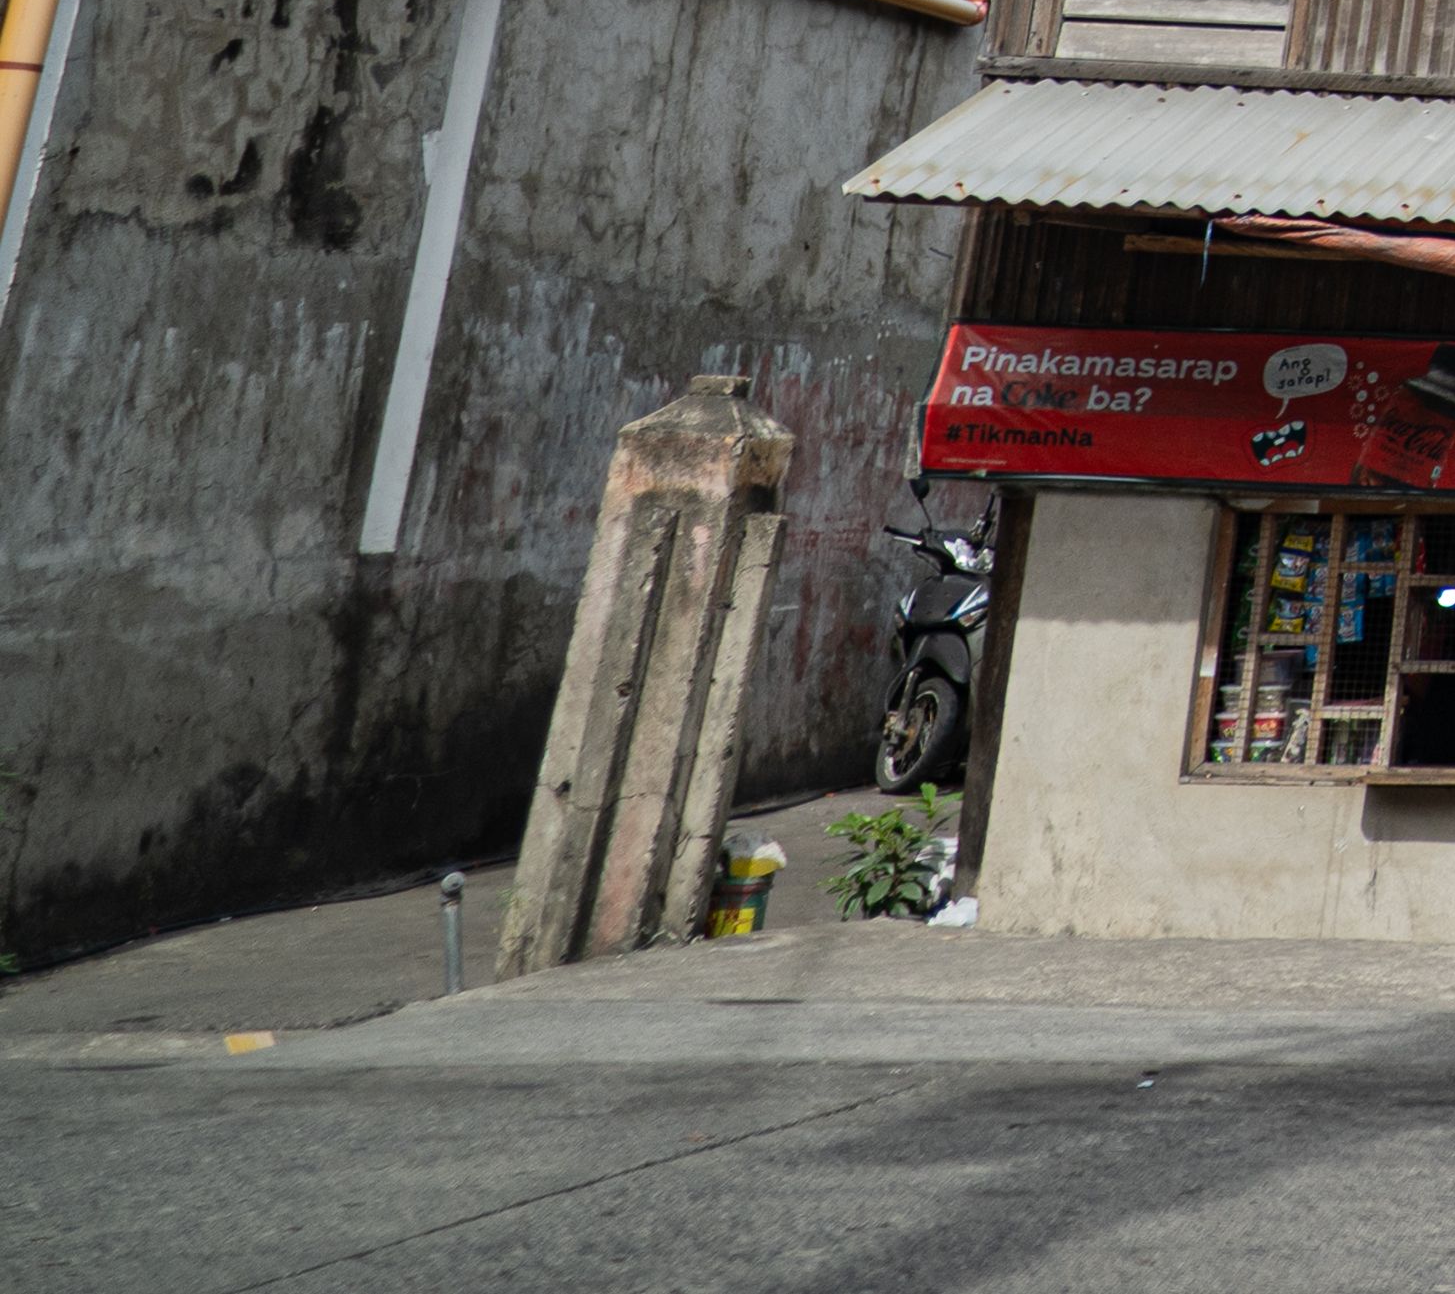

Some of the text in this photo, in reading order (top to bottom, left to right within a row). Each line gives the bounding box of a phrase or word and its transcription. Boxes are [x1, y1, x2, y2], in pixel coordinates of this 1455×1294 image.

[961, 346, 1238, 386] Pinakamasarap
[1279, 358, 1311, 376] Ang
[1277, 368, 1331, 390] sarap!
[951, 379, 1152, 412] na Coke ba?
[945, 423, 1093, 448] #TikmanNa
